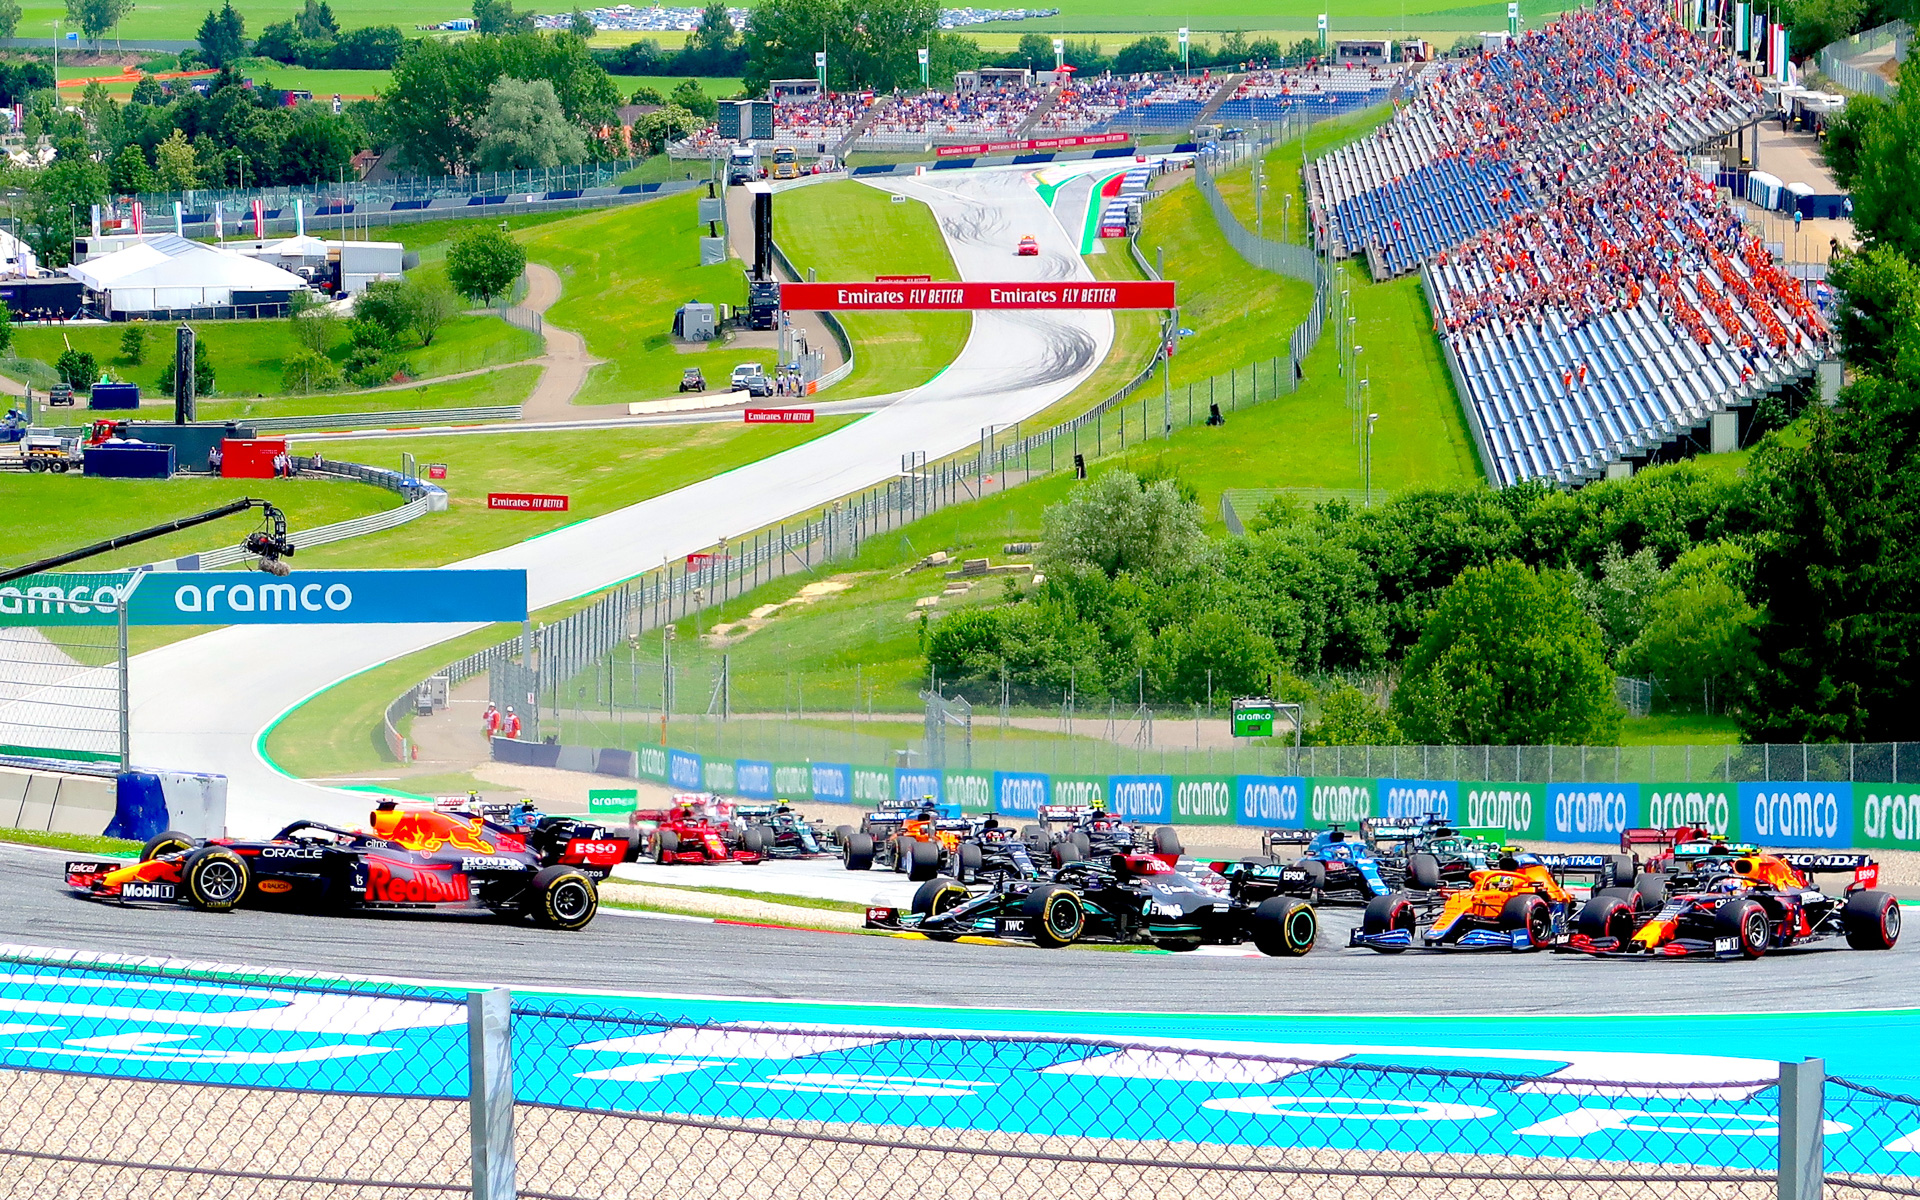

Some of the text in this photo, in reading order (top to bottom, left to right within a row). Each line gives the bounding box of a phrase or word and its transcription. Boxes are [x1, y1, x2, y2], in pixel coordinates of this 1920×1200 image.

[837, 289, 964, 304] Emirates FLY BETTER
[990, 288, 1117, 303] Emirates FLY BETTER
[748, 412, 781, 421] Emirates
[491, 497, 530, 507] Emirates
[174, 583, 353, 612] aramco
[1001, 779, 1044, 810] aramco
[1115, 782, 1163, 815] aramco
[1178, 782, 1229, 816] aramco
[1244, 783, 1297, 820] aramco
[1312, 785, 1370, 821] aramco
[1387, 787, 1449, 820] aramco
[1468, 790, 1532, 832] aramco
[1555, 792, 1627, 833] aramco
[1650, 792, 1729, 834] aramco
[1755, 792, 1838, 838] aramco
[365, 838, 388, 848] citrix
[575, 843, 617, 854] ESSO
[262, 848, 323, 859] ORACLE
[1783, 854, 1860, 866] HONDA
[68, 862, 98, 873] telcel
[462, 857, 524, 866] HONDA
[1283, 871, 1306, 880] EPSON
[122, 883, 160, 898] Mobil
[1004, 920, 1024, 932] IWC
